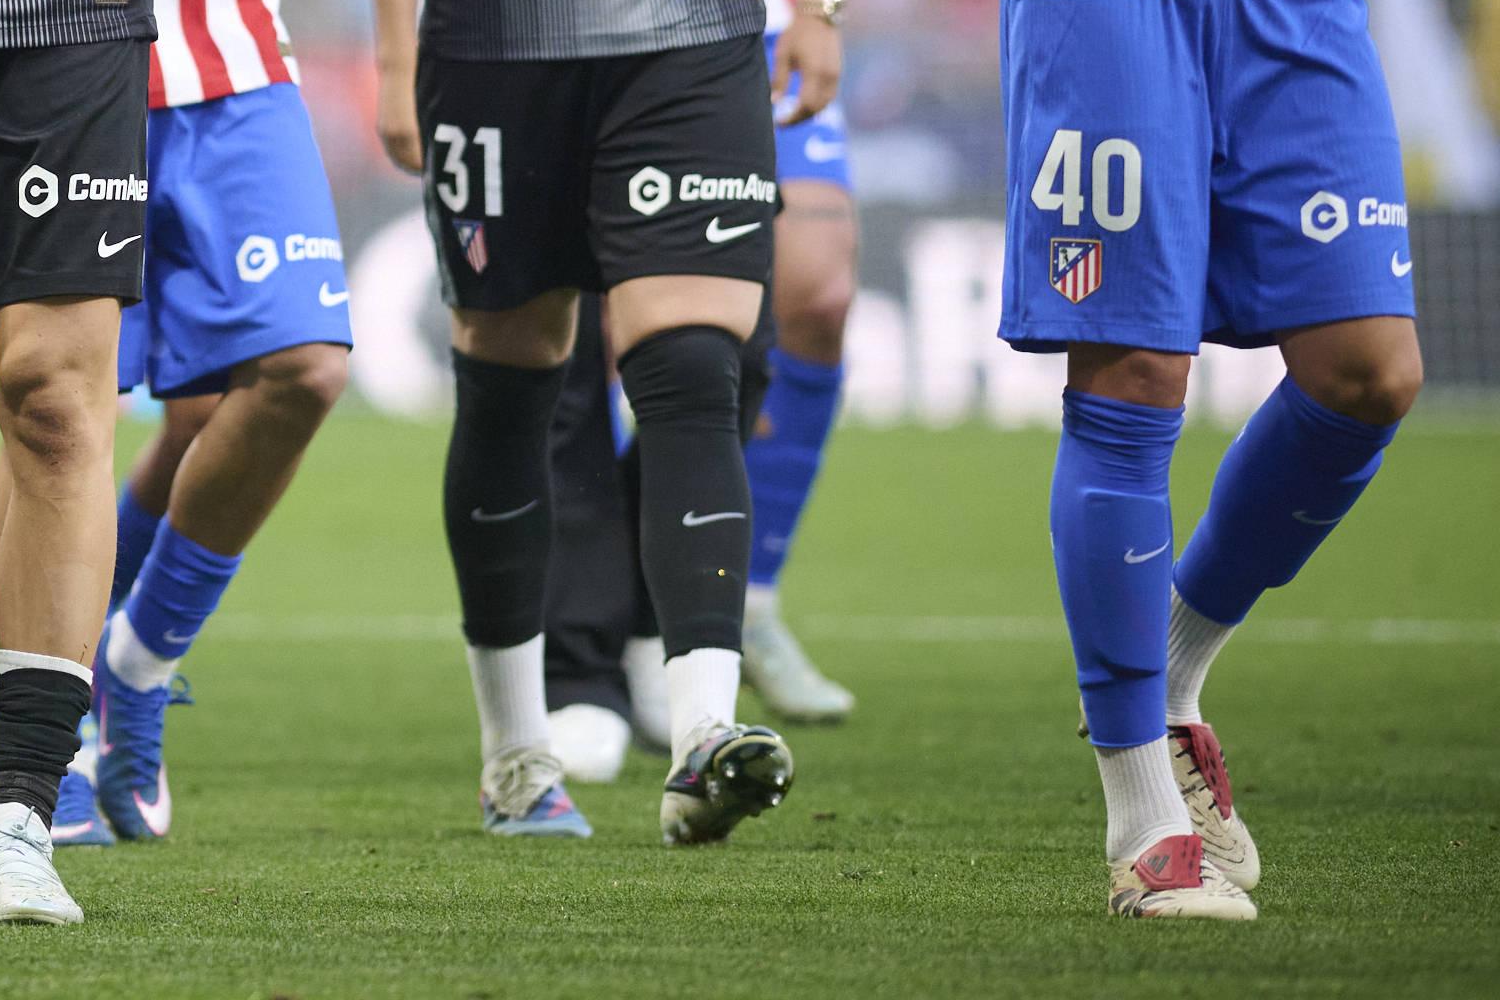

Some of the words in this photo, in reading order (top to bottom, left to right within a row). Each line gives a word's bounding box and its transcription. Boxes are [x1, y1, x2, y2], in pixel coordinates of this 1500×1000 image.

[434, 123, 503, 217] 31
[679, 173, 777, 203] ComAve
[1030, 129, 1142, 232] 40
[1358, 197, 1408, 228] Com
